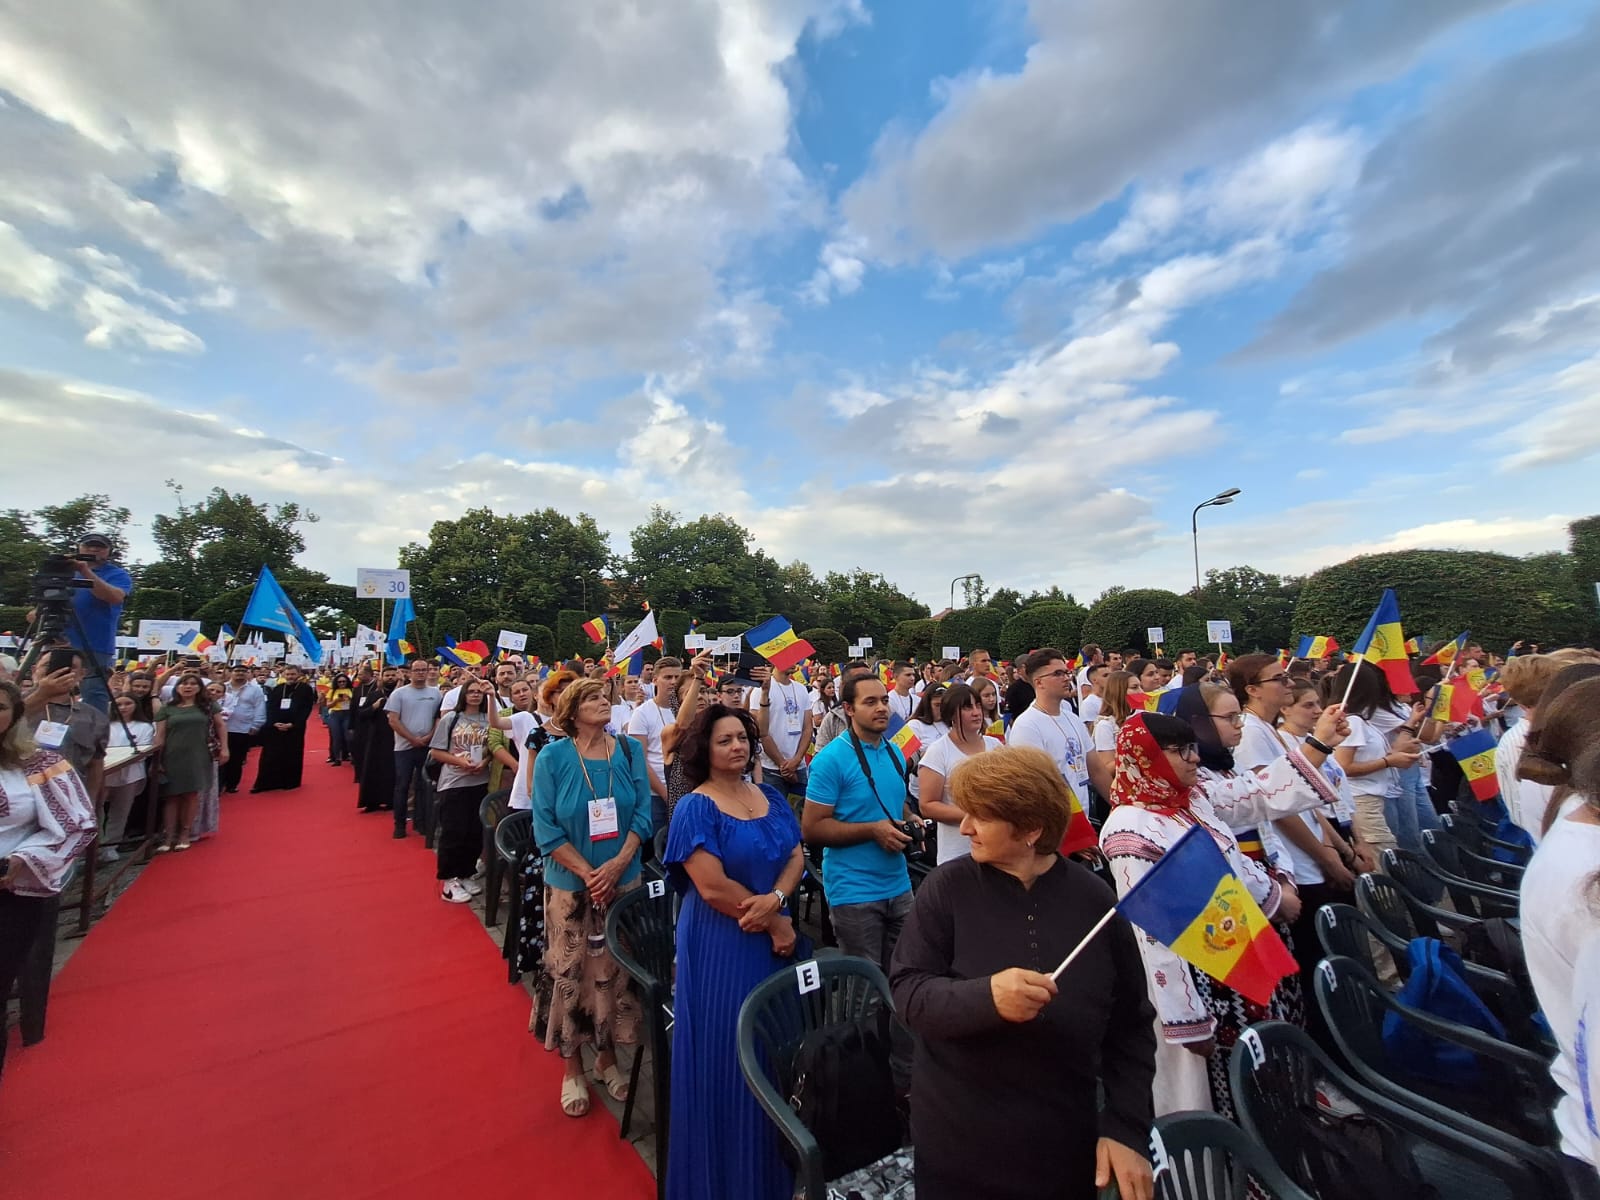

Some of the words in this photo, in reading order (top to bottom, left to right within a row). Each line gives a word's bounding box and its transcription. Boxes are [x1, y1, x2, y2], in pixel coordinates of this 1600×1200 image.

[388, 580, 406, 593] 30
[731, 642, 740, 651] 52
[652, 881, 661, 894] E
[802, 967, 815, 988] E
